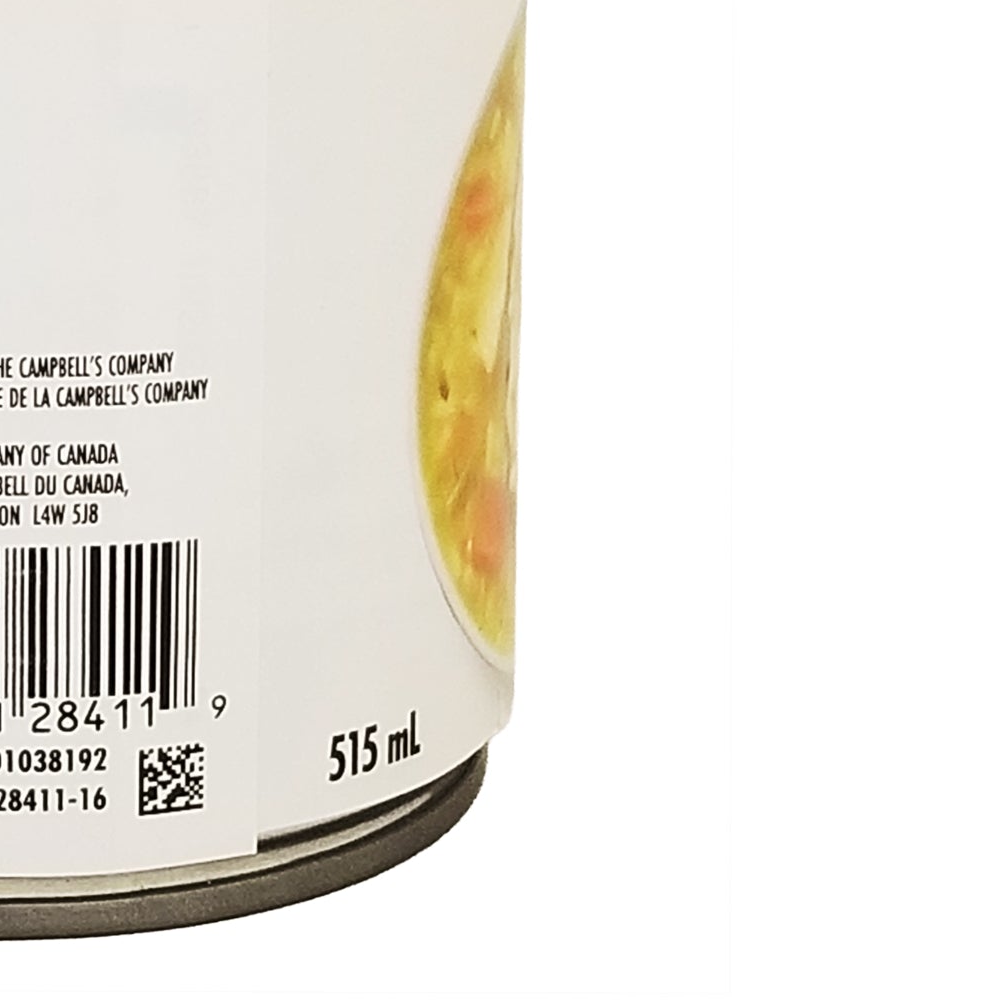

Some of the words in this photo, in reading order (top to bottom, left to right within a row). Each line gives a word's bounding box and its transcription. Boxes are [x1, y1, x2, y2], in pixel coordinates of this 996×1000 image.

[19, 355, 102, 379] CAMPBELL'S
[108, 351, 174, 377] COMPANY
[9, 387, 27, 408] DE
[33, 387, 51, 408] LA
[56, 383, 139, 408] CAMPBELL'S
[144, 378, 208, 404] COMPANY
[31, 444, 51, 466] OF
[57, 443, 119, 466] CANADA
[34, 475, 57, 496] DU
[63, 472, 129, 497] CANADA,
[33, 504, 66, 526] L4W
[72, 503, 99, 525] 5J8
[31, 697, 154, 733] 28411
[212, 695, 226, 719] 9
[329, 724, 377, 781] 515
[388, 710, 420, 764] mL
